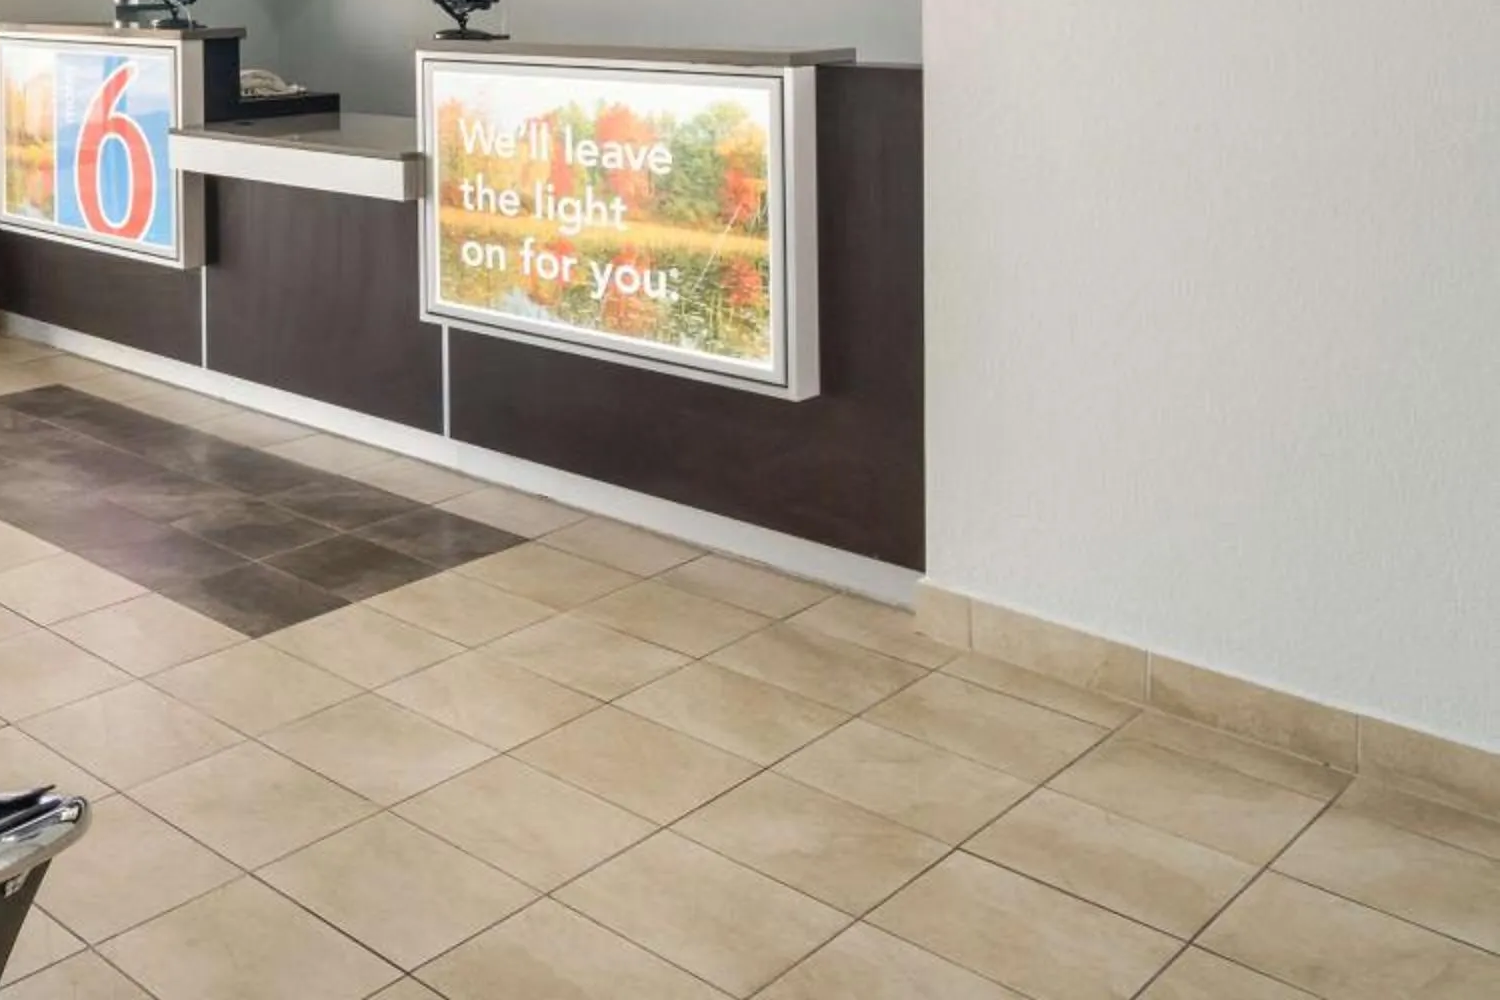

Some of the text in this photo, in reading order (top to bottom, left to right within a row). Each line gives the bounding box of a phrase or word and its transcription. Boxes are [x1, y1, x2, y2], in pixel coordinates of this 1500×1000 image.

[74, 60, 157, 242] 6
[459, 117, 673, 175] We'll leave
[460, 172, 628, 236] the light
[461, 240, 506, 271] on
[520, 236, 578, 283] for
